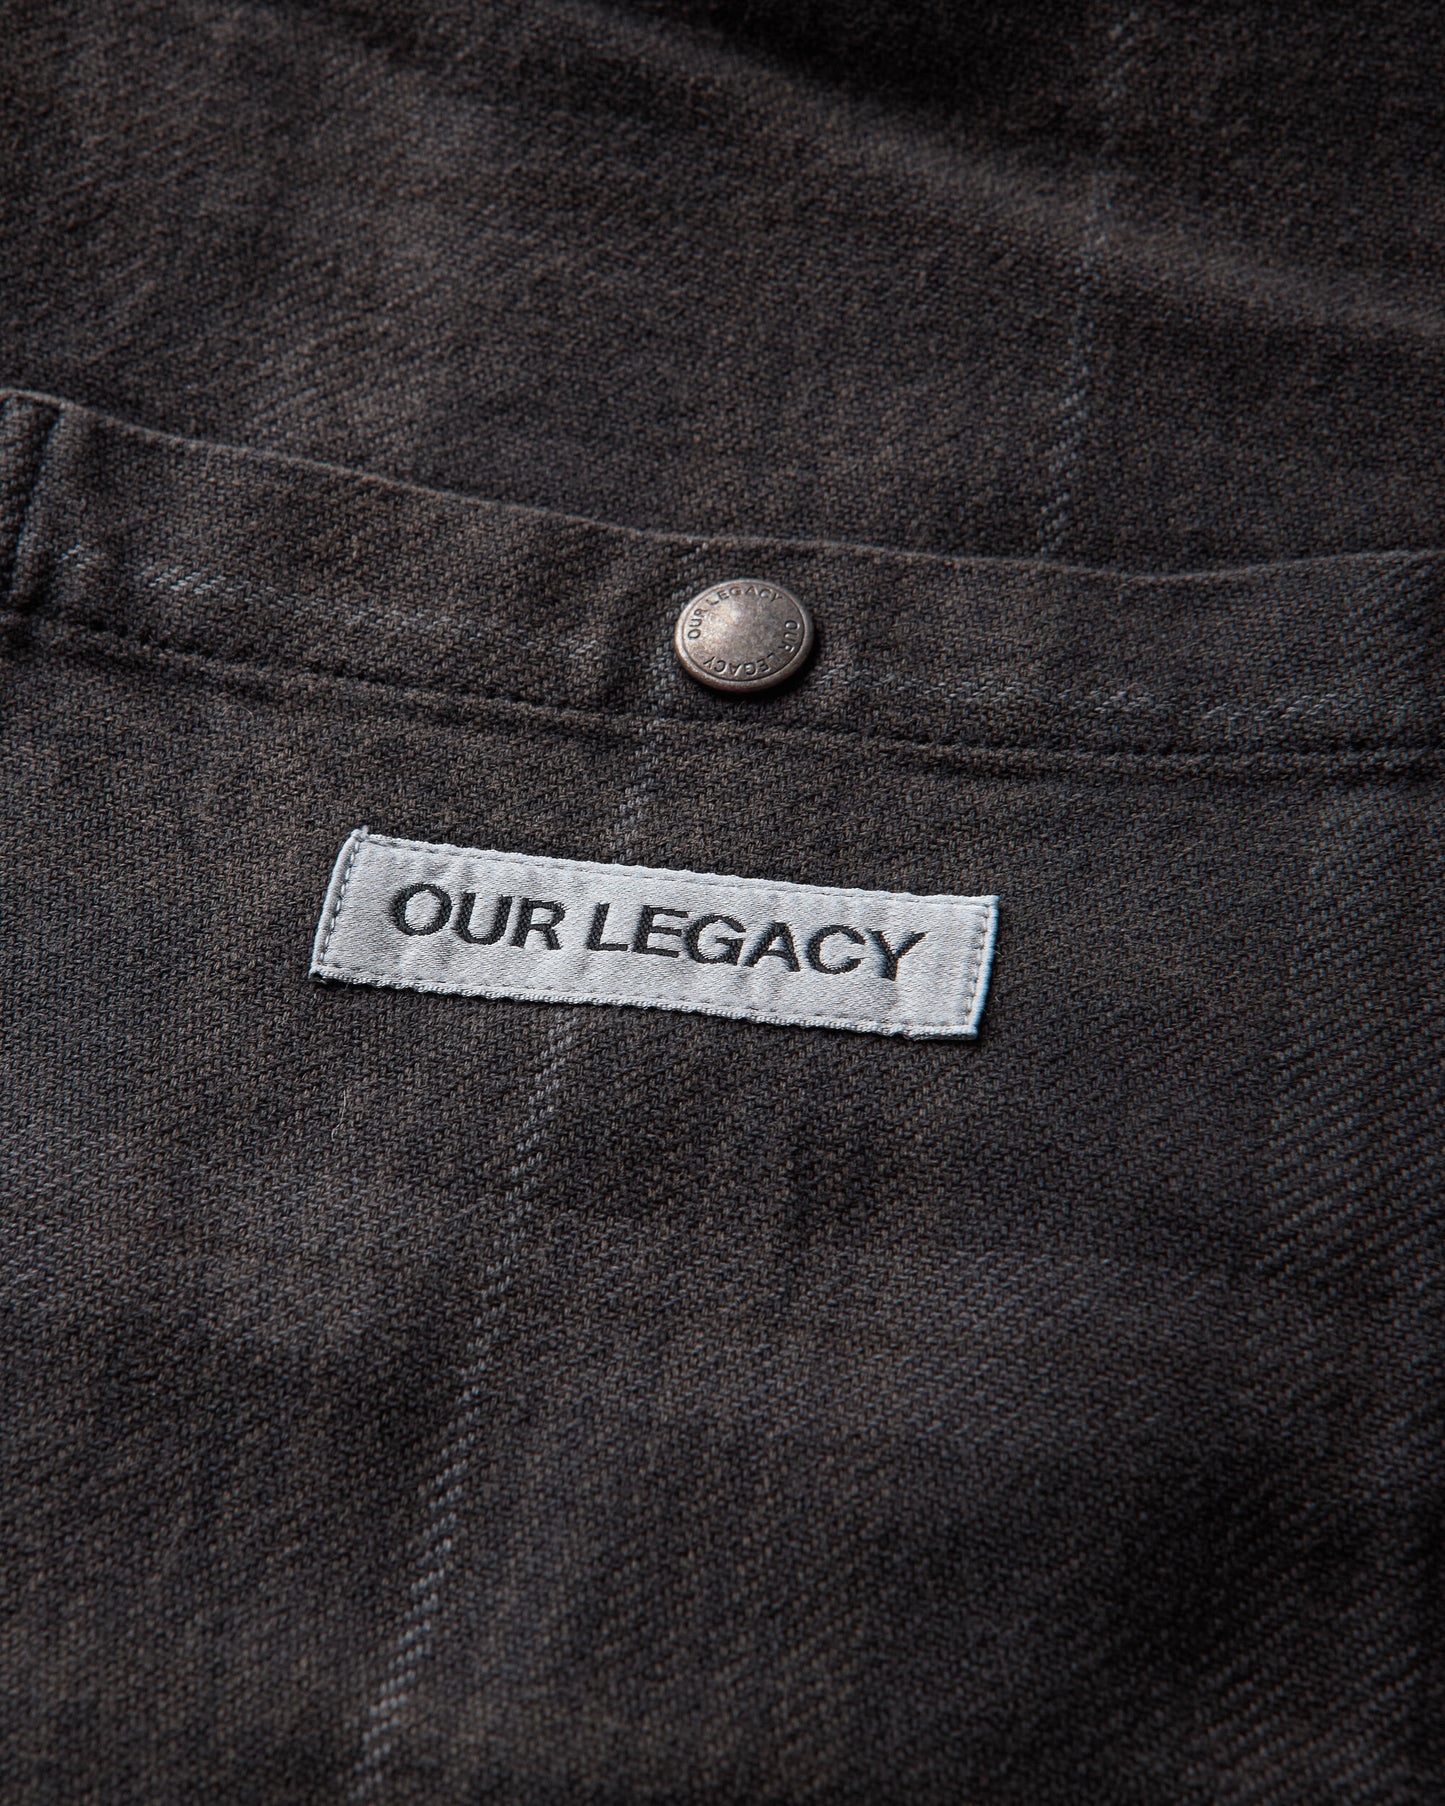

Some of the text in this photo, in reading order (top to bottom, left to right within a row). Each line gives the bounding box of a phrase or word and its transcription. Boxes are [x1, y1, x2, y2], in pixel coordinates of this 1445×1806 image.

[688, 586, 782, 639] OUR LEGACY
[703, 620, 800, 676] OUR LEGACY
[390, 882, 926, 981] OUR LEGACY
